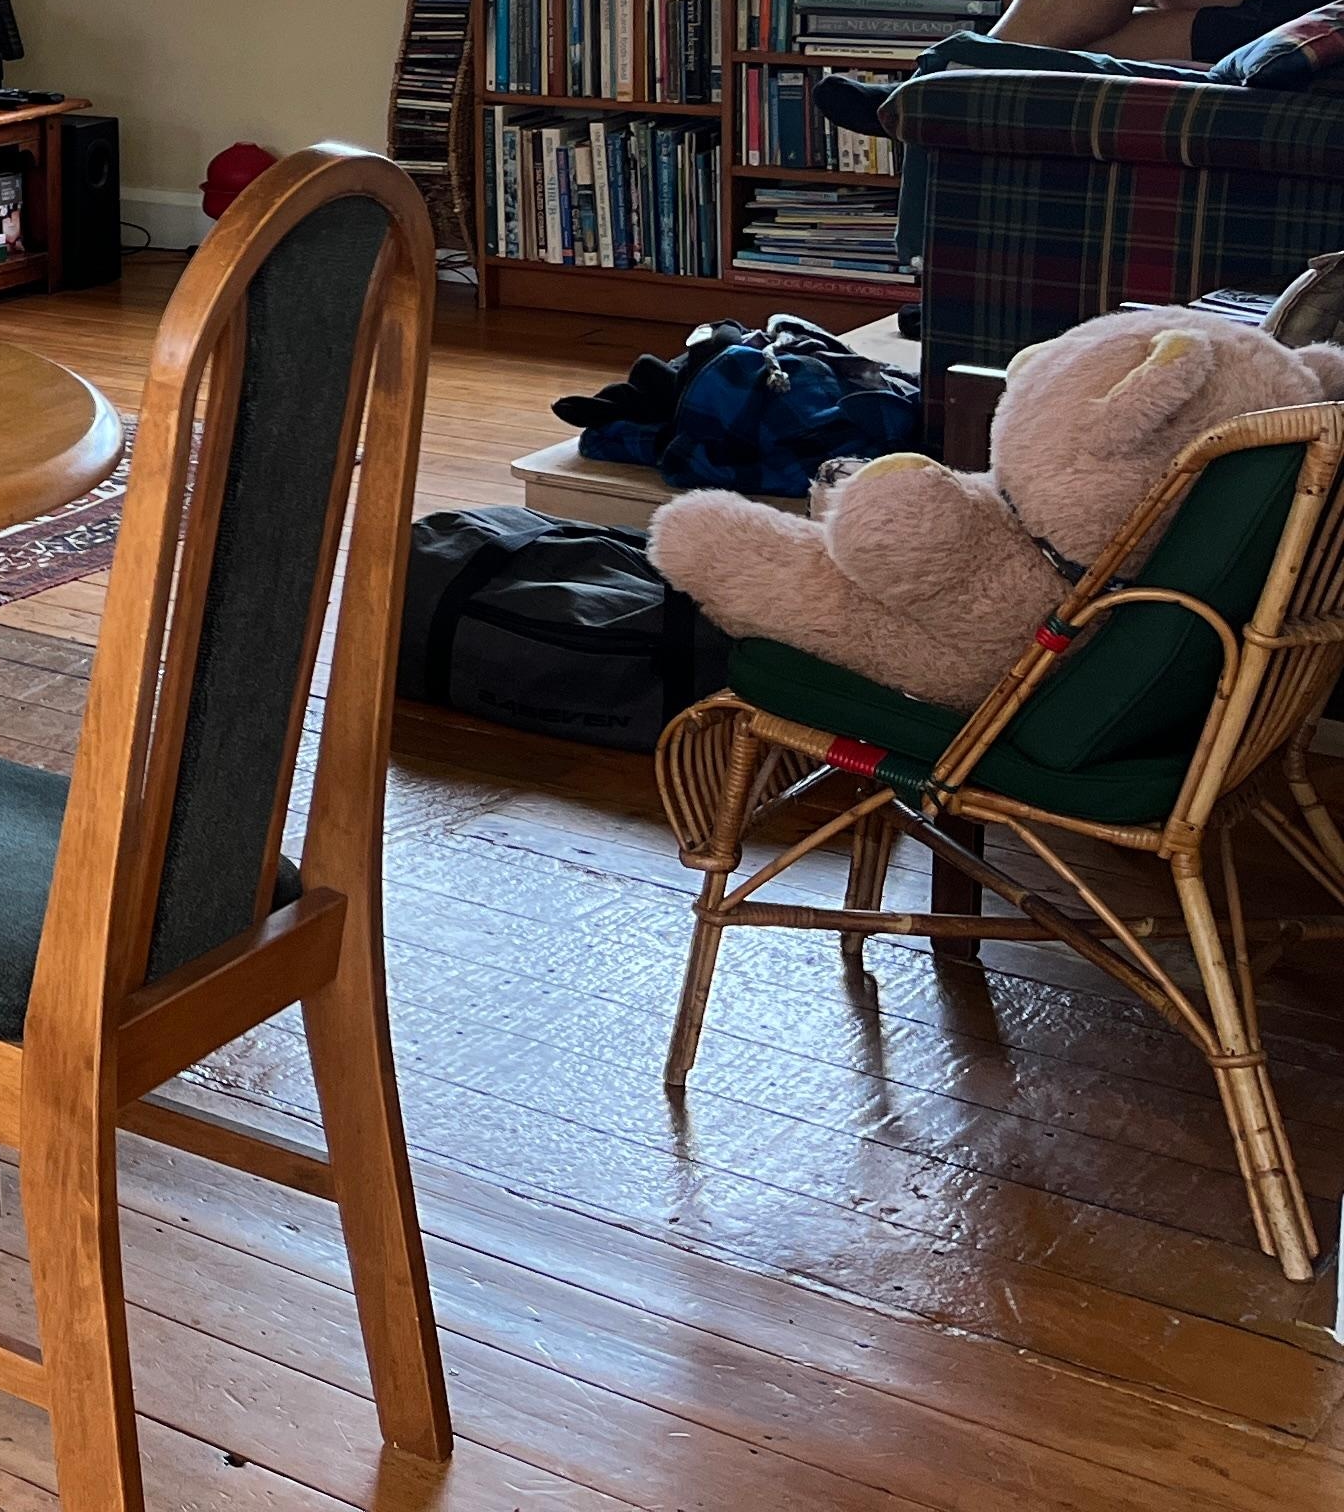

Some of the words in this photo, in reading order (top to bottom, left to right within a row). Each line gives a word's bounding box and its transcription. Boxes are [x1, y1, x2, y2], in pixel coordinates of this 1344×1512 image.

[847, 19, 880, 32] NEW
[884, 19, 953, 33] ZEALAND
[547, 176, 558, 216] SHRUB
